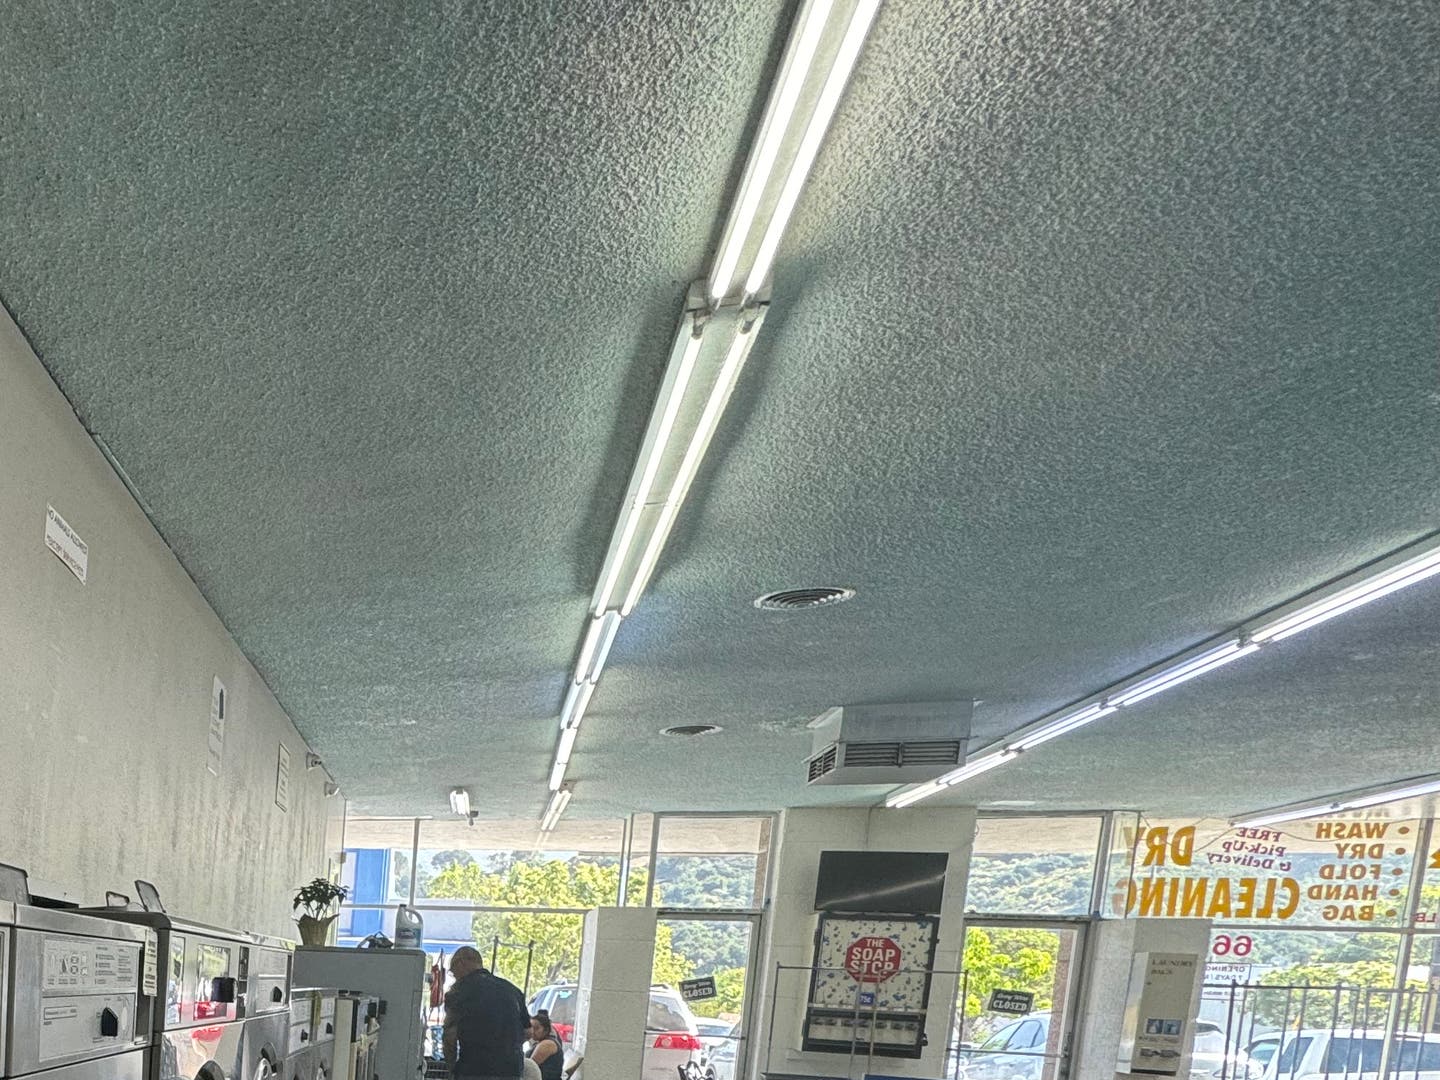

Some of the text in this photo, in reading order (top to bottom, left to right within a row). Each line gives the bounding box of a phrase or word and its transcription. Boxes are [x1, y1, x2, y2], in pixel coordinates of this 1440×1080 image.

[866, 938, 885, 947] THE
[852, 947, 896, 961] SOAP
[993, 1000, 1027, 1011] CLOSED
